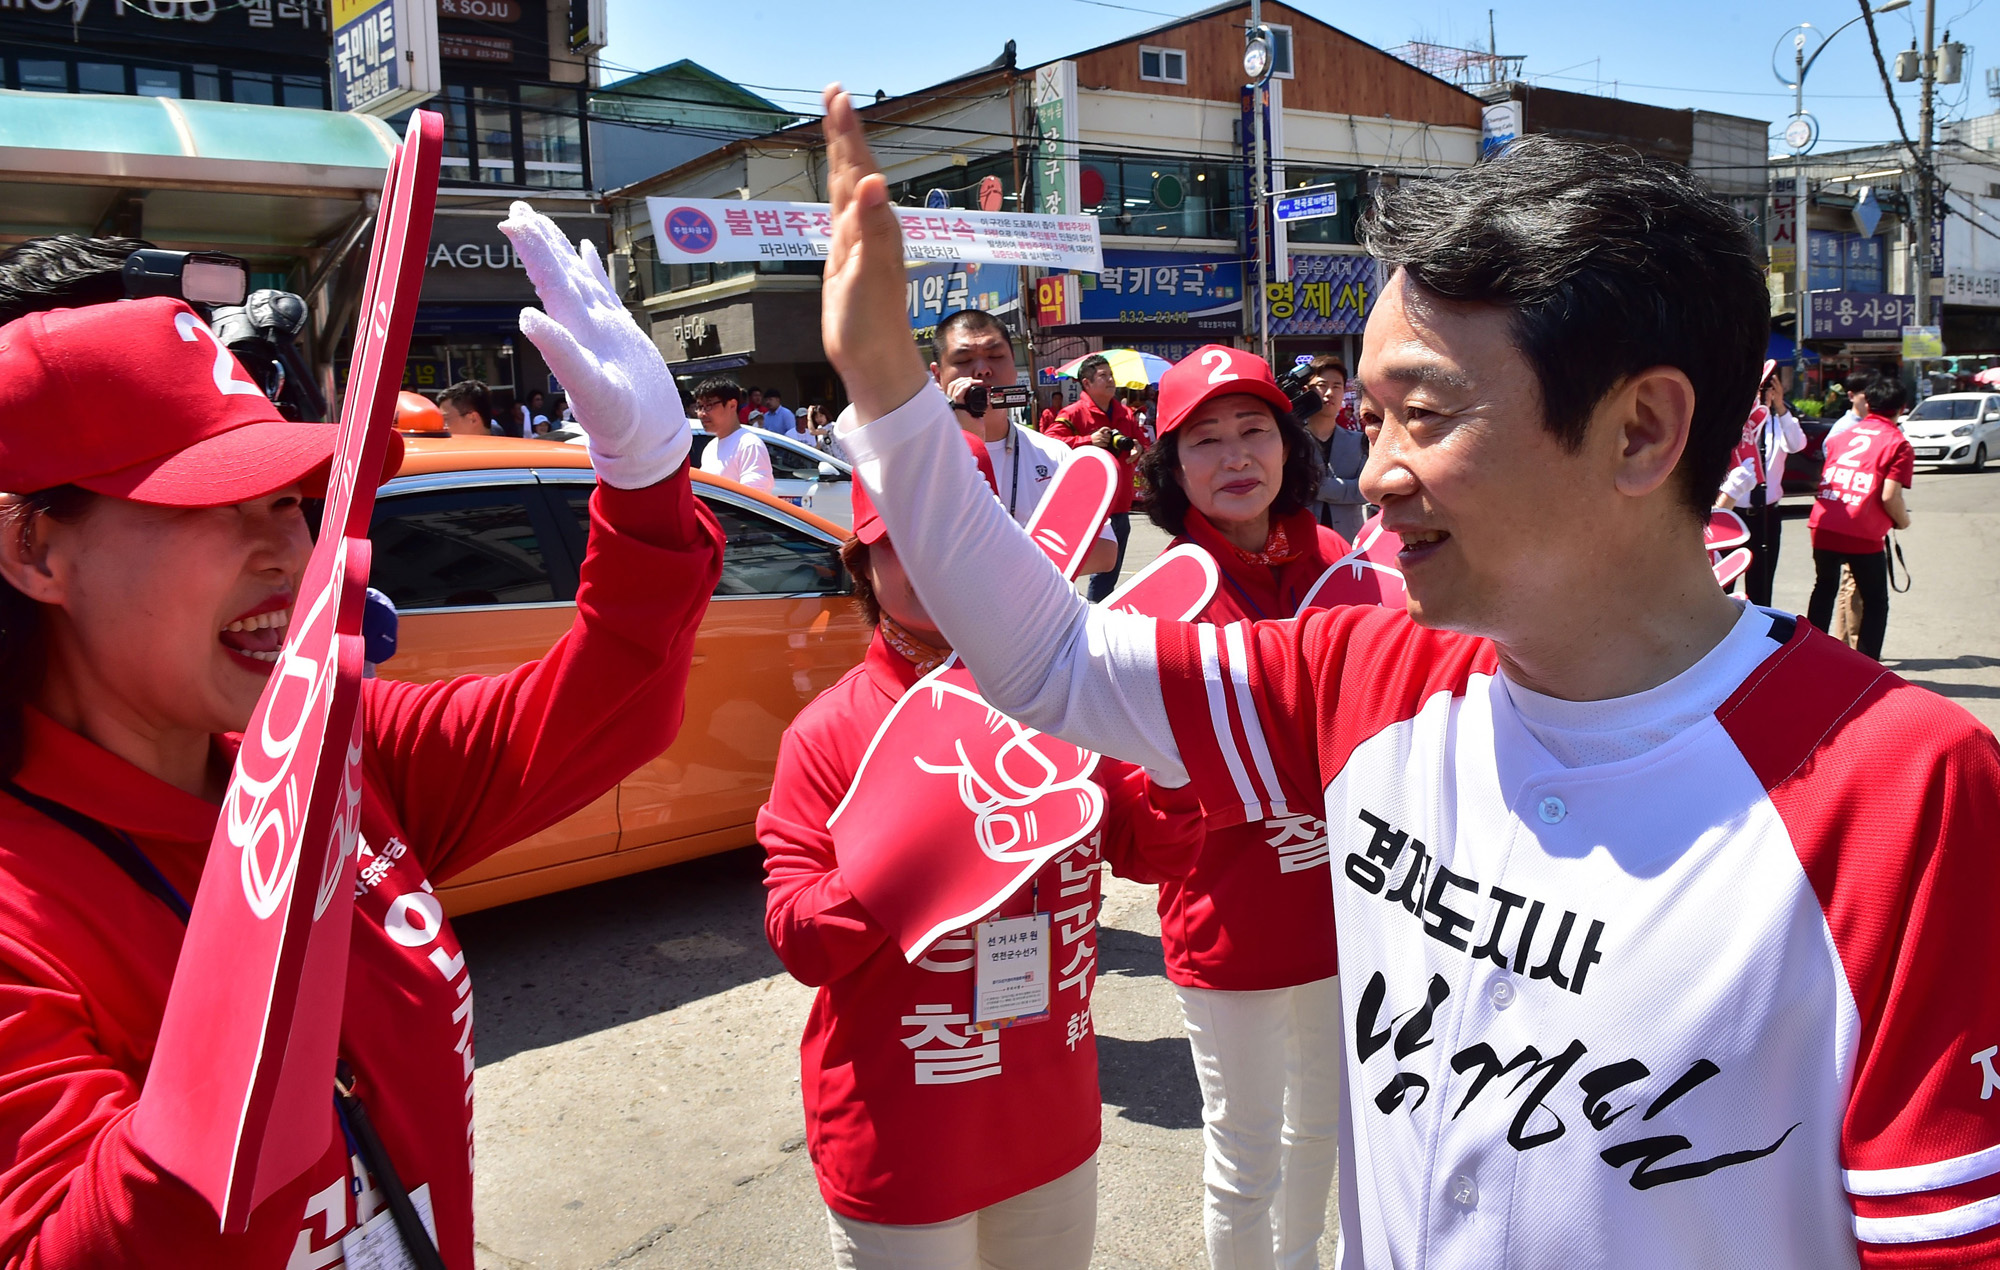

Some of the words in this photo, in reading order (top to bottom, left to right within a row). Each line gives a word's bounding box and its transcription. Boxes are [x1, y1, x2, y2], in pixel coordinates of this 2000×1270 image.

[460, 2, 509, 18] SOJU
[337, 6, 396, 83] 국민마트
[1039, 102, 1062, 124] 한마음
[1043, 127, 1062, 215] 당구장
[1057, 221, 1092, 232] 불법주정차
[1018, 241, 1053, 251] 불법주정차
[1100, 266, 1205, 297] 럭키약국
[1039, 283, 1062, 324] 약
[1266, 281, 1369, 318] 형제사
[1119, 310, 1190, 324] 832-2340
[174, 312, 265, 396] 2
[1201, 350, 1239, 385] 2
[1836, 435, 1872, 468] 2
[987, 930, 1039, 948] 선거사무원
[991, 947, 1038, 962] 연천군수선거
[1355, 971, 1803, 1191] 남경필
